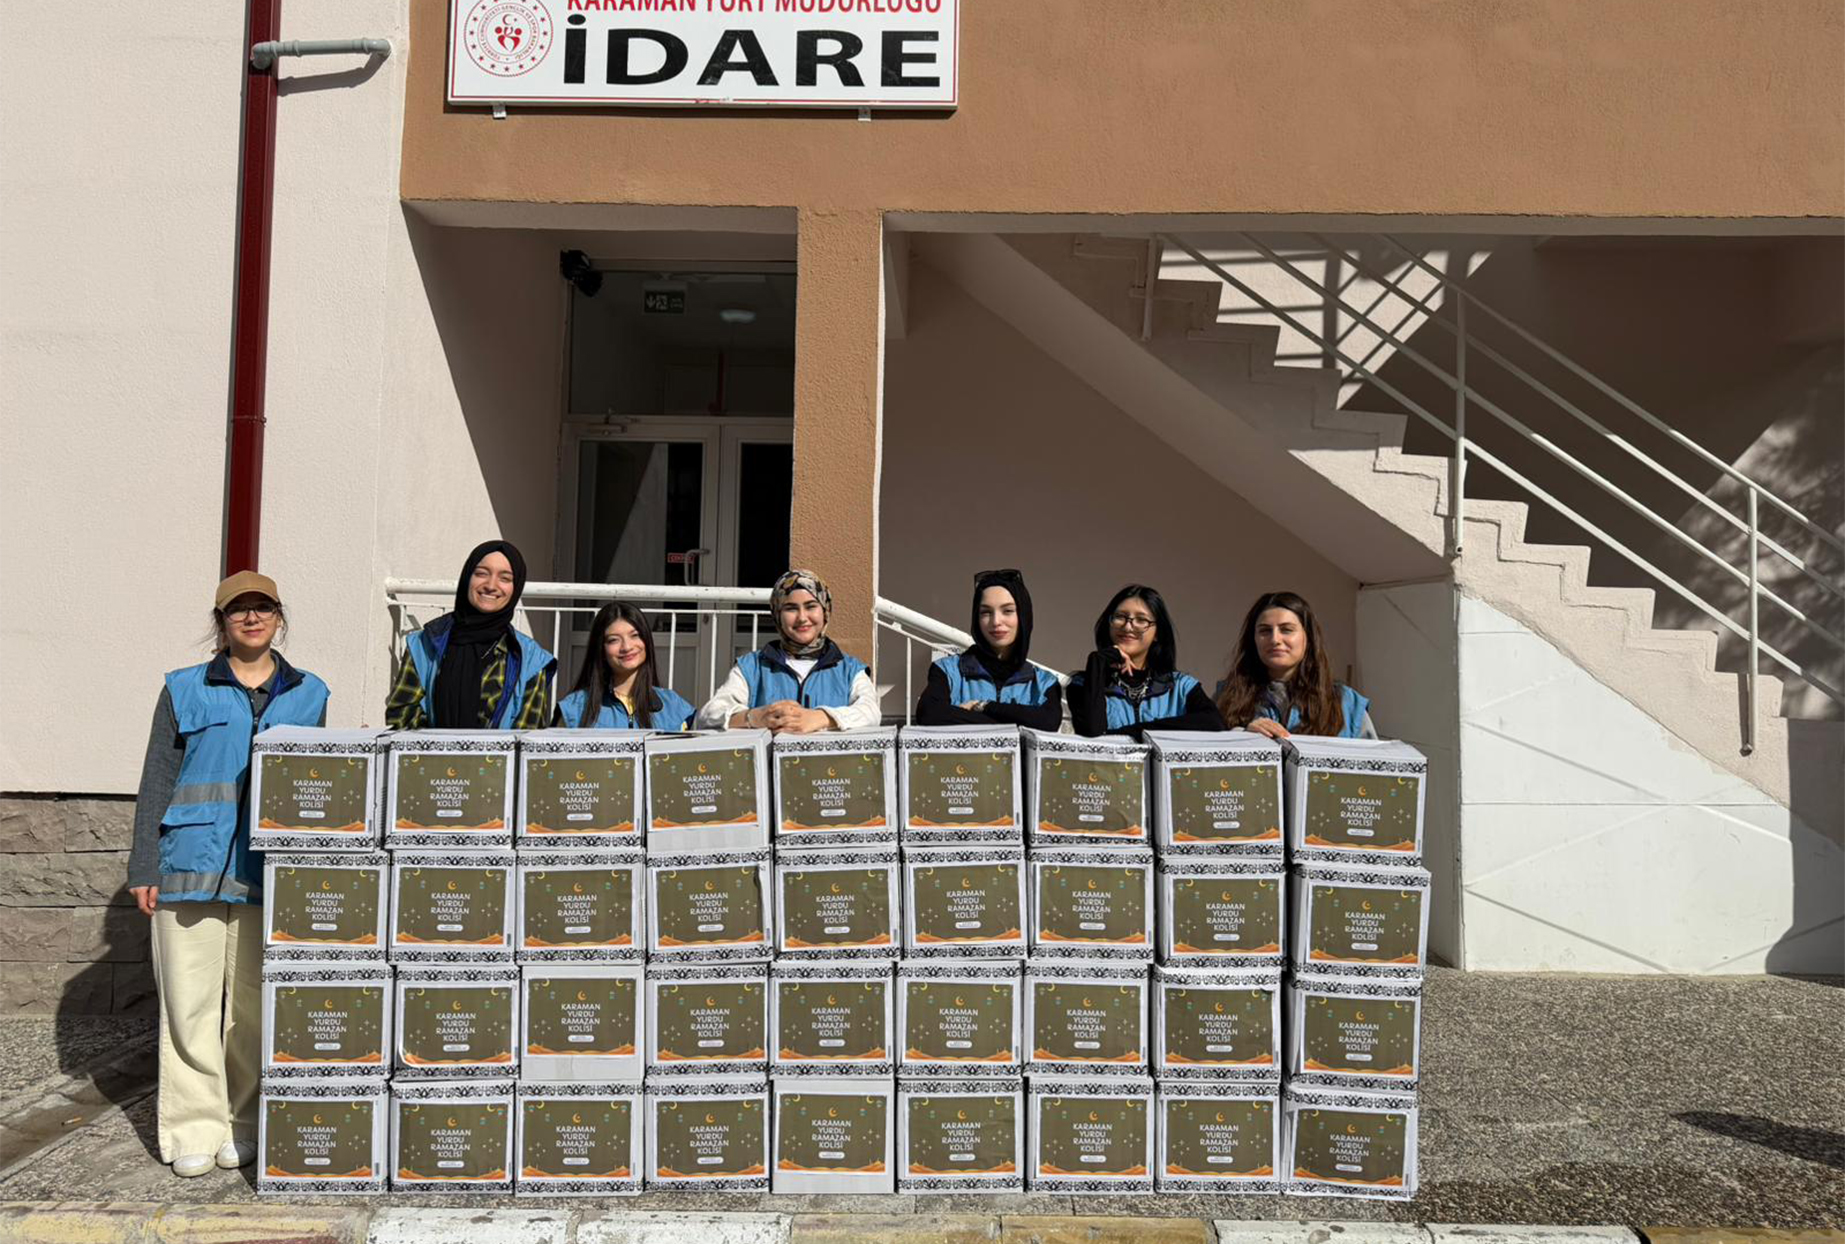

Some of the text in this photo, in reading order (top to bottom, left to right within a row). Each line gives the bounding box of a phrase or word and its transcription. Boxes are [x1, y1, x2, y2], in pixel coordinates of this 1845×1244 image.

[564, 14, 940, 87] İDARE
[683, 775, 721, 783] KARAMAN
[689, 782, 715, 790] YURDU
[684, 788, 722, 797] RAMAZAN
[691, 795, 715, 804] KOLİSİ
[820, 798, 843, 807] KOLİSİ
[1072, 798, 1110, 806] RAMAZAN
[1341, 798, 1382, 806] KARAMAN
[300, 800, 323, 808] KOLİSİ
[1079, 804, 1102, 812] KOLİSİ
[1347, 804, 1375, 813] YURDU
[1340, 811, 1380, 820] RAMAZAN
[1348, 818, 1372, 827] KOLİSİ
[696, 899, 722, 908] YURDU
[953, 897, 979, 905] YURDU
[690, 907, 728, 915] RAMAZAN
[947, 904, 985, 912] RAMAZAN
[312, 913, 336, 921] KOLİSİ
[698, 913, 721, 922] KOLİSİ
[955, 911, 978, 919] KOLİSİ
[565, 916, 589, 924] KOLİSİ
[824, 916, 848, 924] KOLİSİ
[1351, 919, 1379, 927] YURDU
[1345, 926, 1384, 934] RAMAZAN
[1352, 932, 1376, 941] KOLİSİ
[946, 1030, 970, 1038] KOLİSİ
[1345, 1029, 1372, 1037] YURDU
[1339, 1036, 1378, 1045] RAMAZAN
[1346, 1043, 1371, 1051] KOLİSİ
[1330, 1134, 1370, 1143] KARAMAN
[950, 1143, 973, 1151] KOLİSİ
[1336, 1141, 1363, 1150] YURDU
[697, 1146, 721, 1154] KOLİSİ
[1329, 1148, 1369, 1157] RAMAZAN
[1337, 1154, 1361, 1163] KOLİSİ
